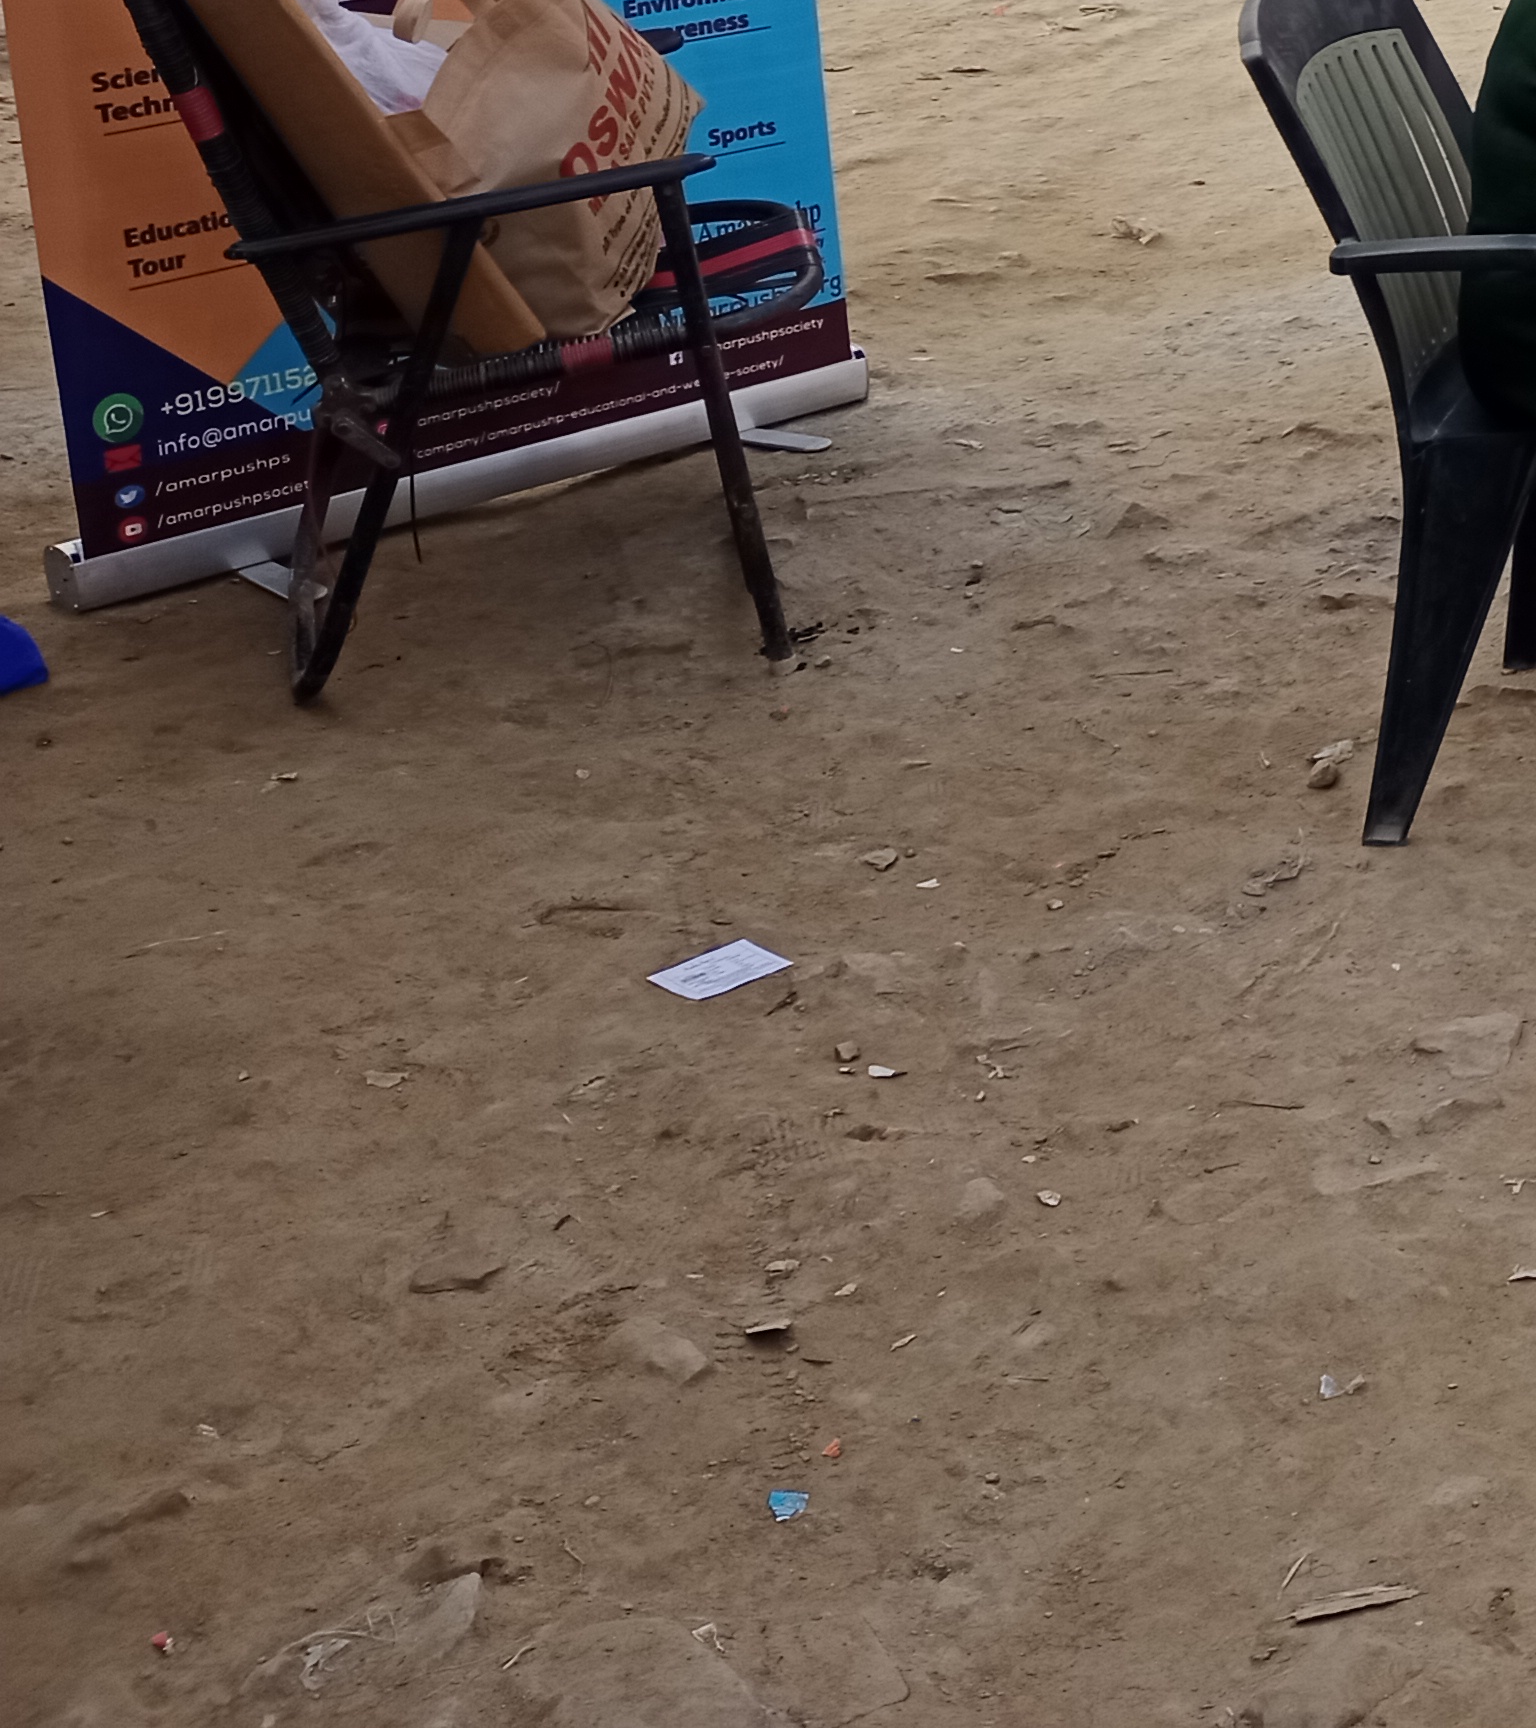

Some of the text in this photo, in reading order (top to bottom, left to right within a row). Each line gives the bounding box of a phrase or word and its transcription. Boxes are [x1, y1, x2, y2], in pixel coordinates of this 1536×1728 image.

[560, 27, 642, 178] OSWA
[707, 120, 776, 148] Sports
[127, 254, 186, 278] Tour
[155, 452, 291, 496] /amarpushps
